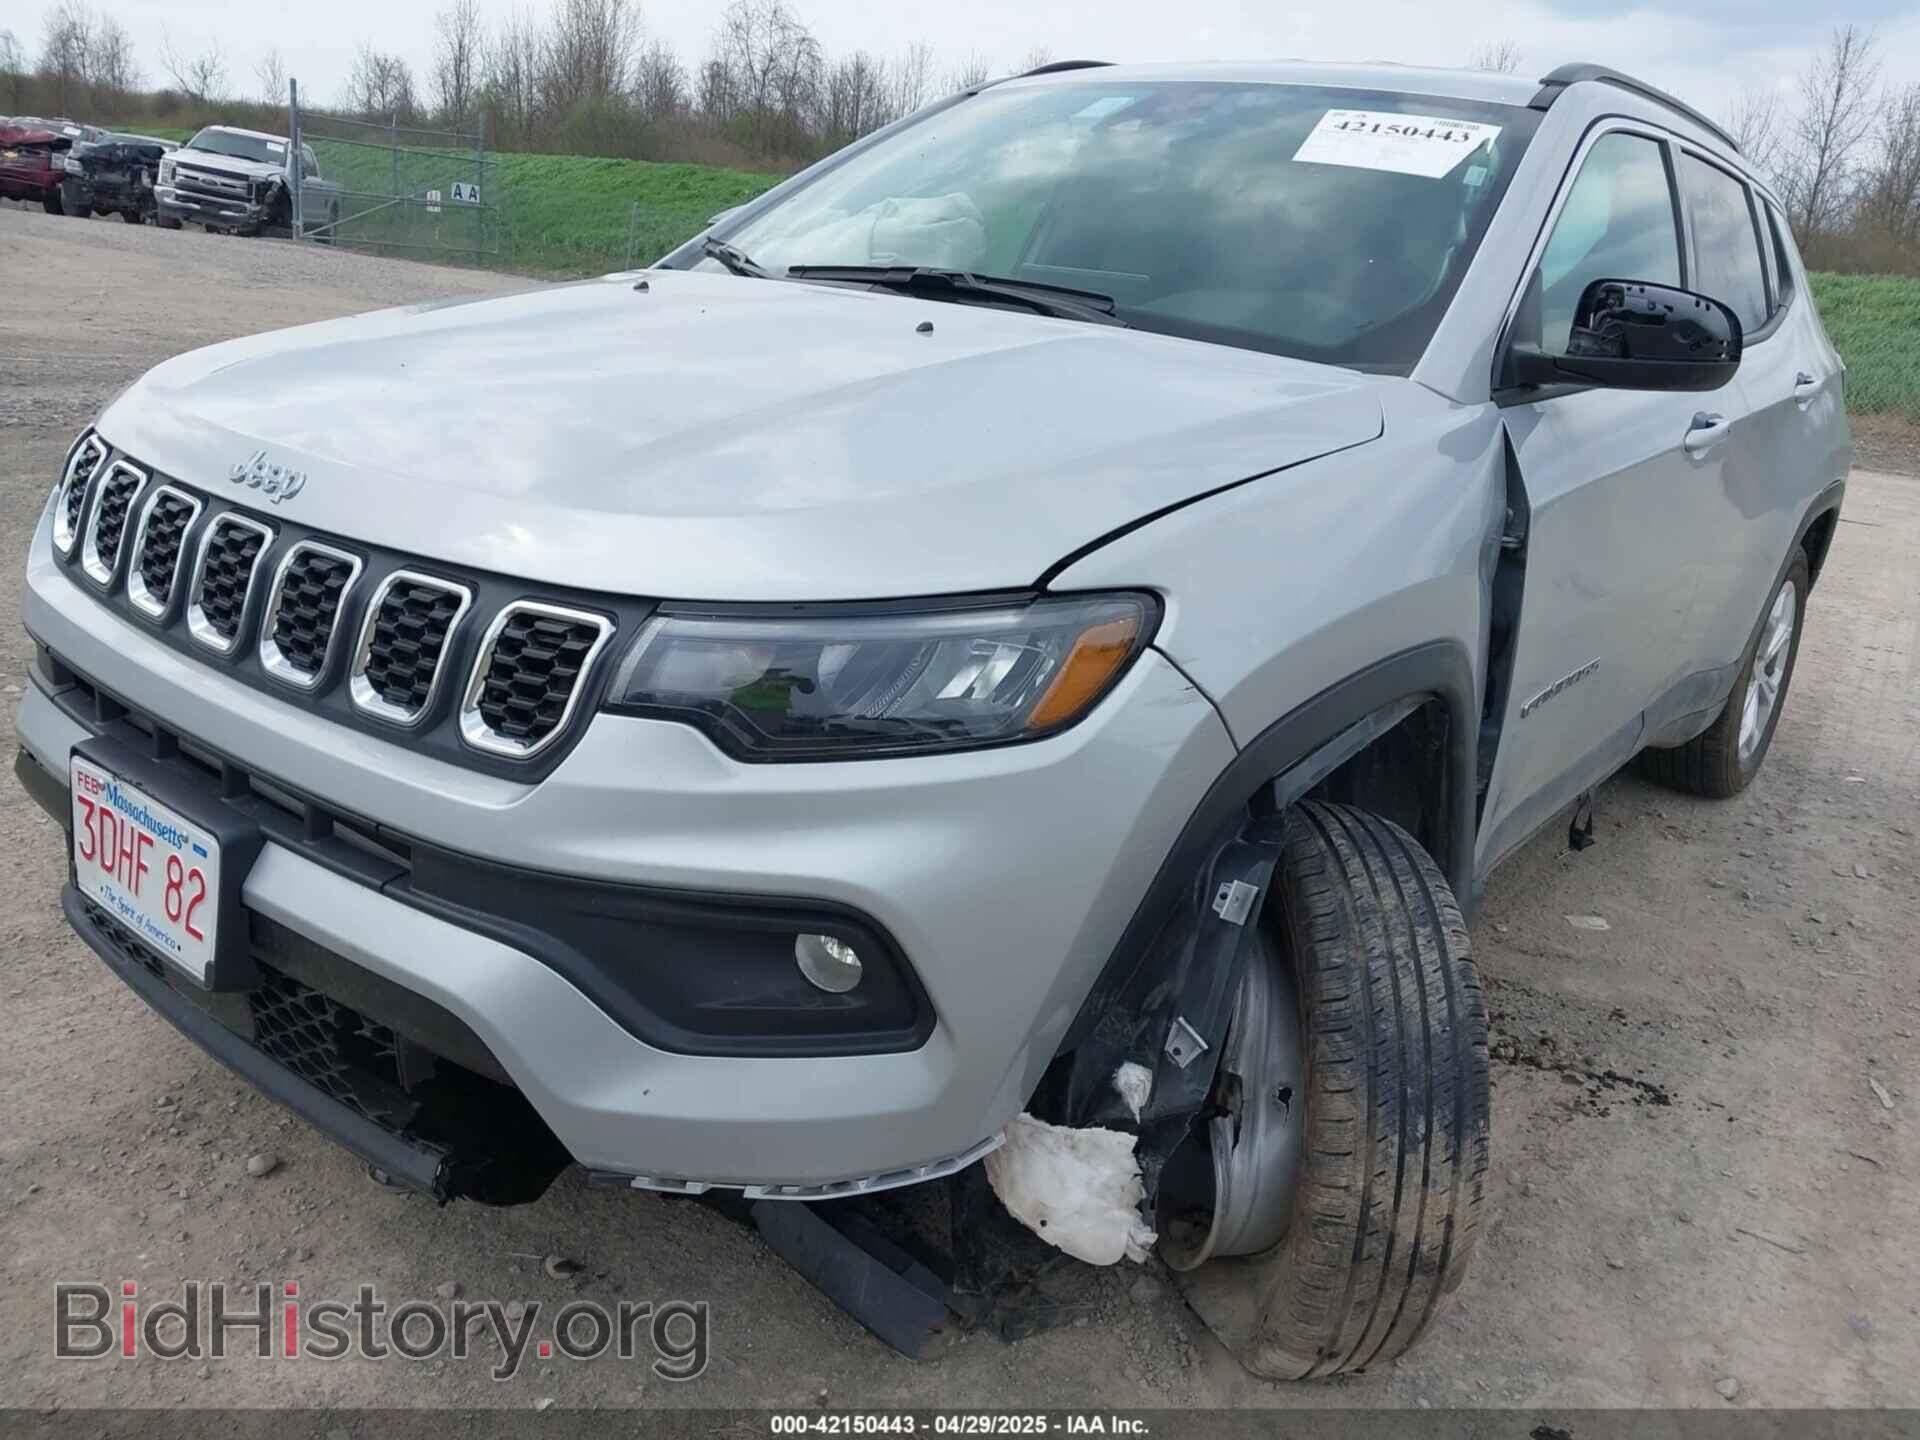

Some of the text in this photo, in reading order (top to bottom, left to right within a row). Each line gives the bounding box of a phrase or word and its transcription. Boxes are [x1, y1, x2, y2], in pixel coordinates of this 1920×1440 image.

[1333, 121, 1470, 143] 42150443
[229, 450, 307, 504] Jeep
[77, 770, 99, 796] FEB
[105, 783, 184, 851] Massachusetts
[164, 854, 206, 942] 82
